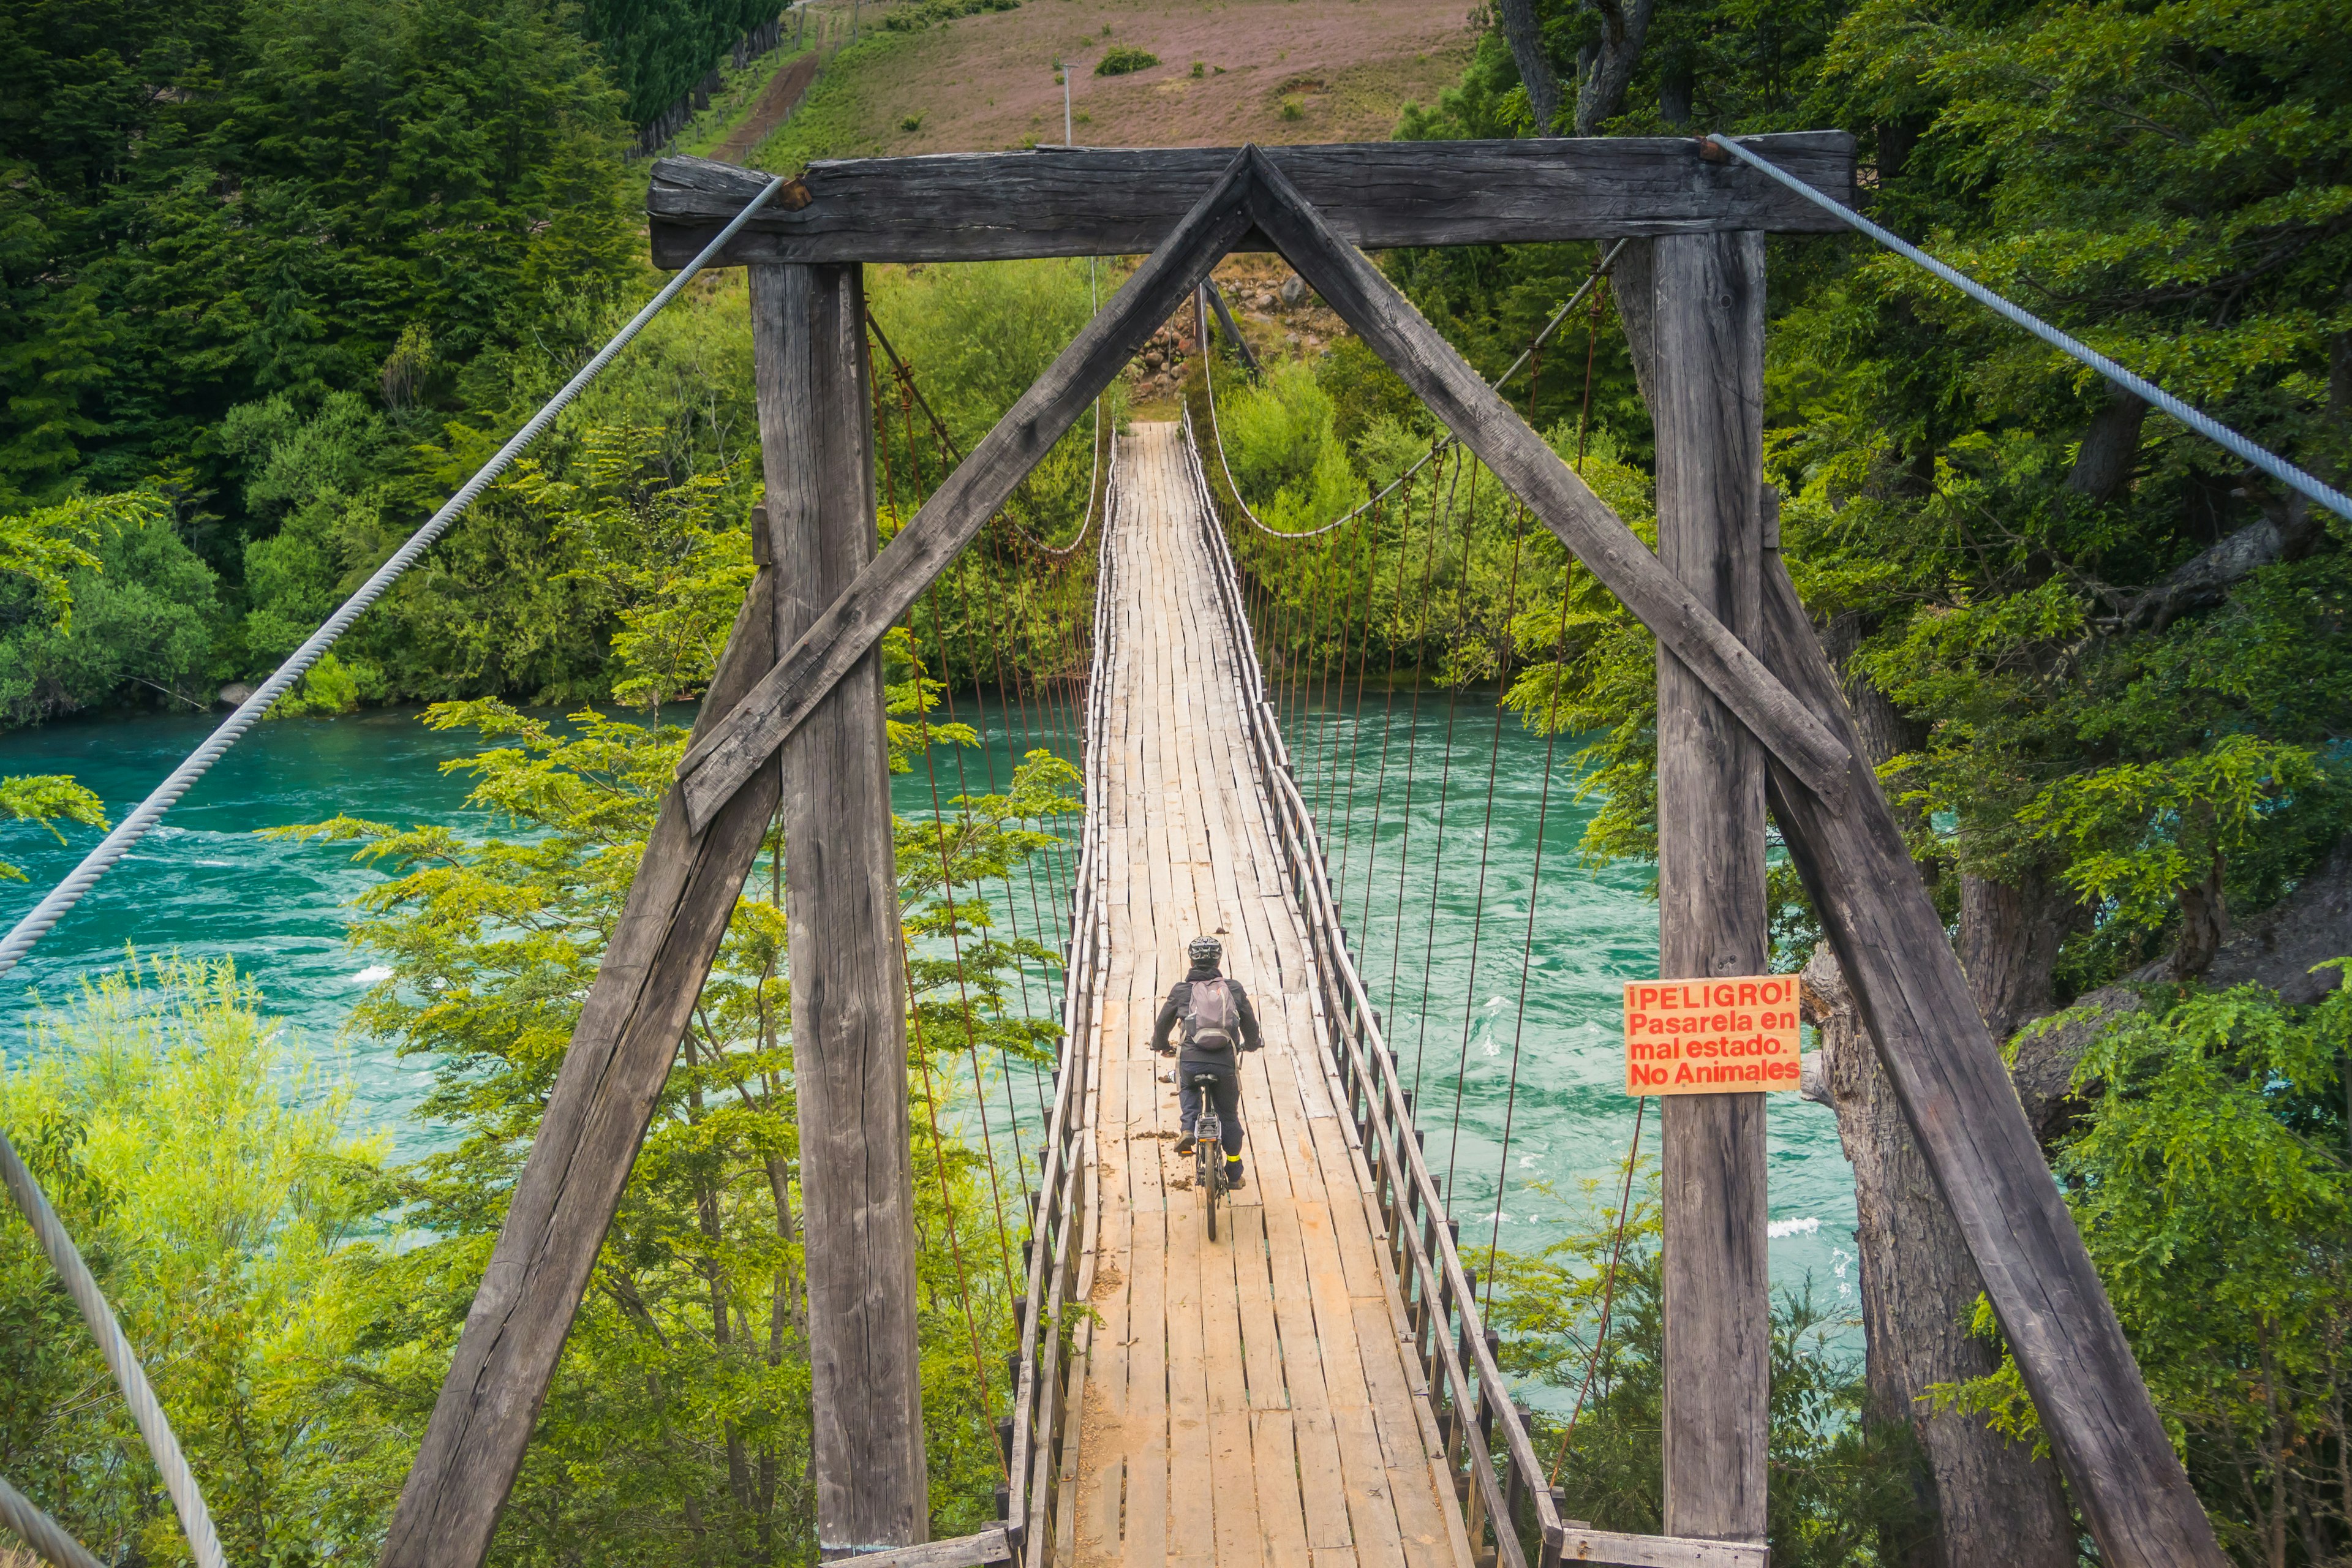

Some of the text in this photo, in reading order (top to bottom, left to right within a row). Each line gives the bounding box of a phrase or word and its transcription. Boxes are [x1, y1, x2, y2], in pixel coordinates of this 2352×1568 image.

[1629, 1010, 1795, 1036] Pasarela en
[1630, 1033, 1788, 1060] mal estado.
[1631, 1059, 1800, 1086] No Animales
